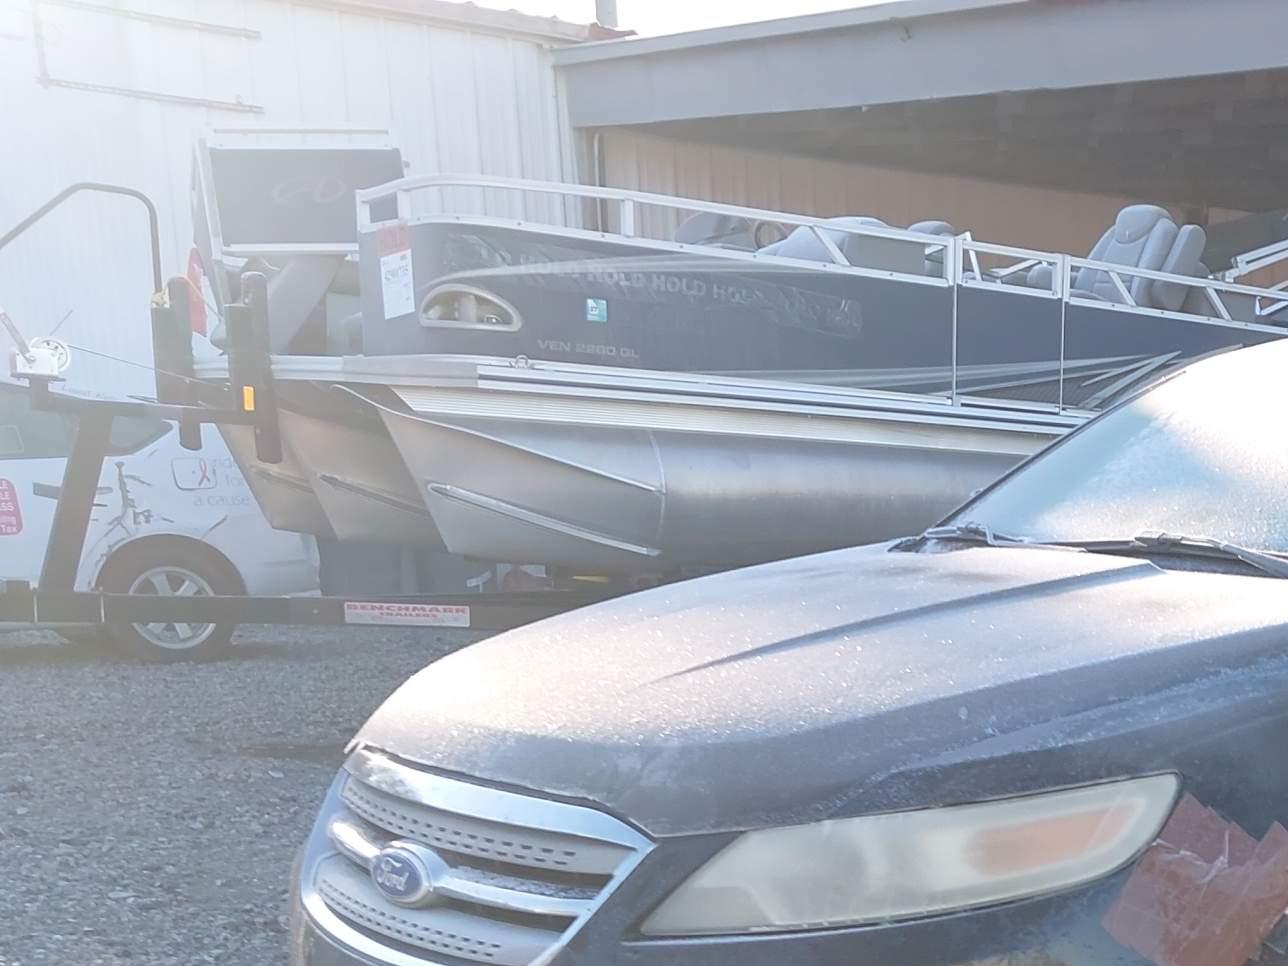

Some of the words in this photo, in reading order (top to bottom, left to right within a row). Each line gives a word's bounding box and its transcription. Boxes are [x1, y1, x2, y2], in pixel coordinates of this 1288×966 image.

[652, 273, 707, 297] HOLD
[537, 339, 571, 353] VEN
[620, 347, 641, 359] GL
[376, 856, 410, 891] Ford
